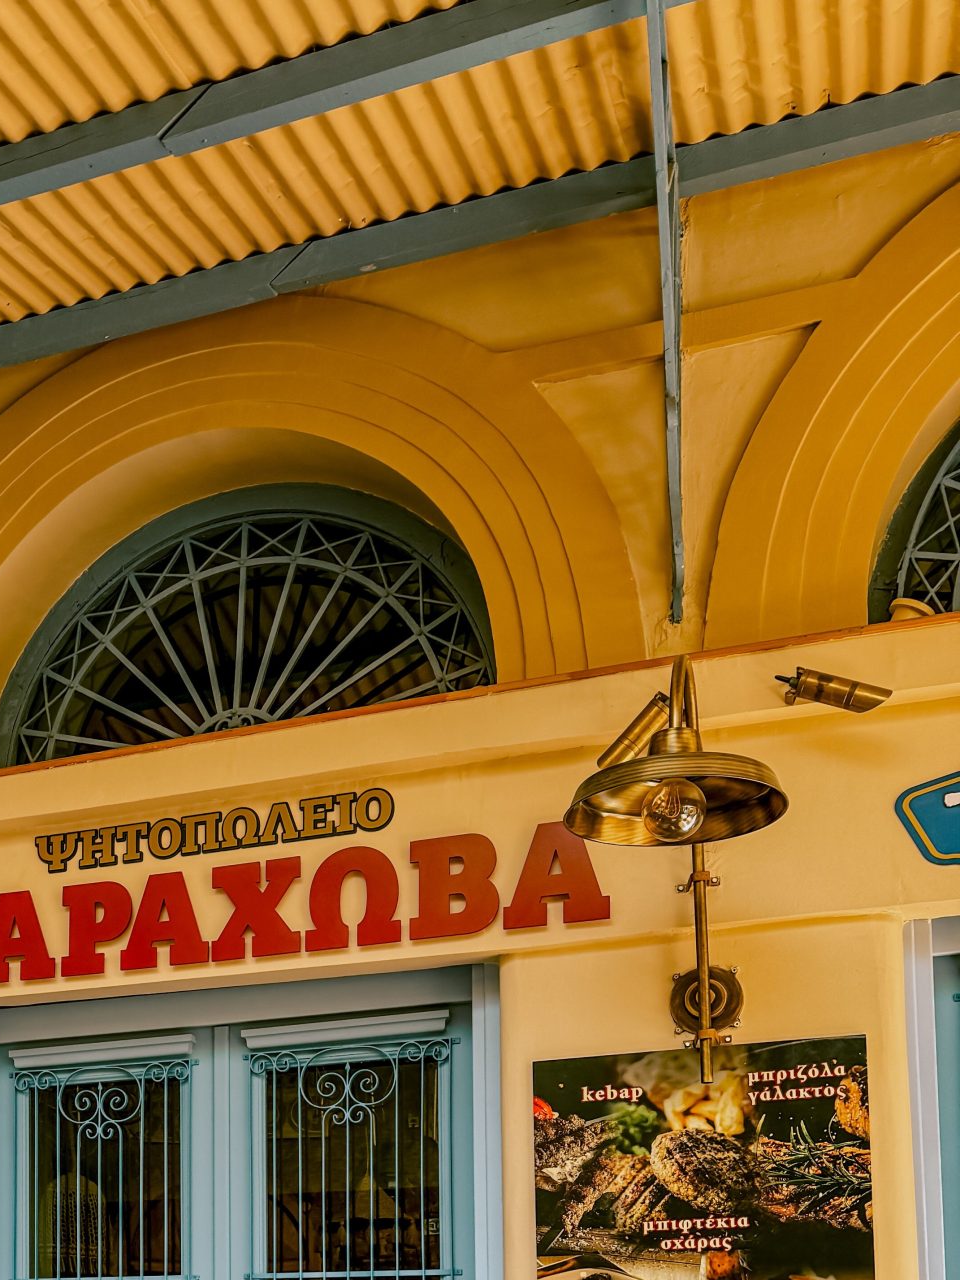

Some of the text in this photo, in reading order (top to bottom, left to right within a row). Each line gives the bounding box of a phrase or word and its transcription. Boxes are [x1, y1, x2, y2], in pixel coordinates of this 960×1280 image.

[36, 787, 395, 874] ΨΗΤΟΠΩΛΕΙΟ
[747, 1062, 847, 1086] μπριζόλα
[581, 1085, 643, 1103] kebap
[642, 1216, 750, 1235] μπιφτέκια
[660, 1233, 733, 1252] σχάρας
